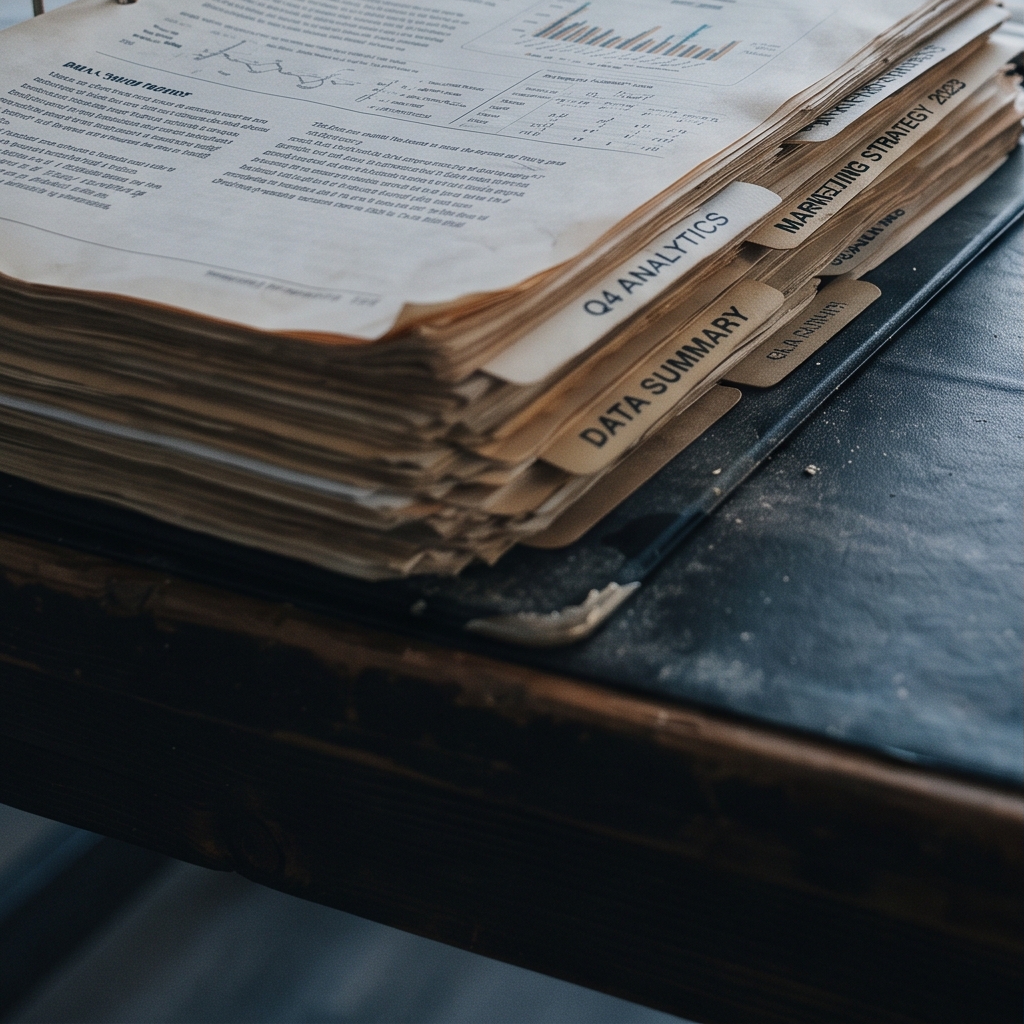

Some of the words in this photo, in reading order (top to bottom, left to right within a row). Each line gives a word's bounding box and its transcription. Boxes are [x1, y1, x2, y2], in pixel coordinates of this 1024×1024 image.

[861, 104, 934, 162] STRATEGY
[583, 283, 623, 317] Q4
[623, 211, 730, 294] ANALYTICS
[579, 395, 651, 449] DATA
[640, 305, 750, 395] SUMMARY
